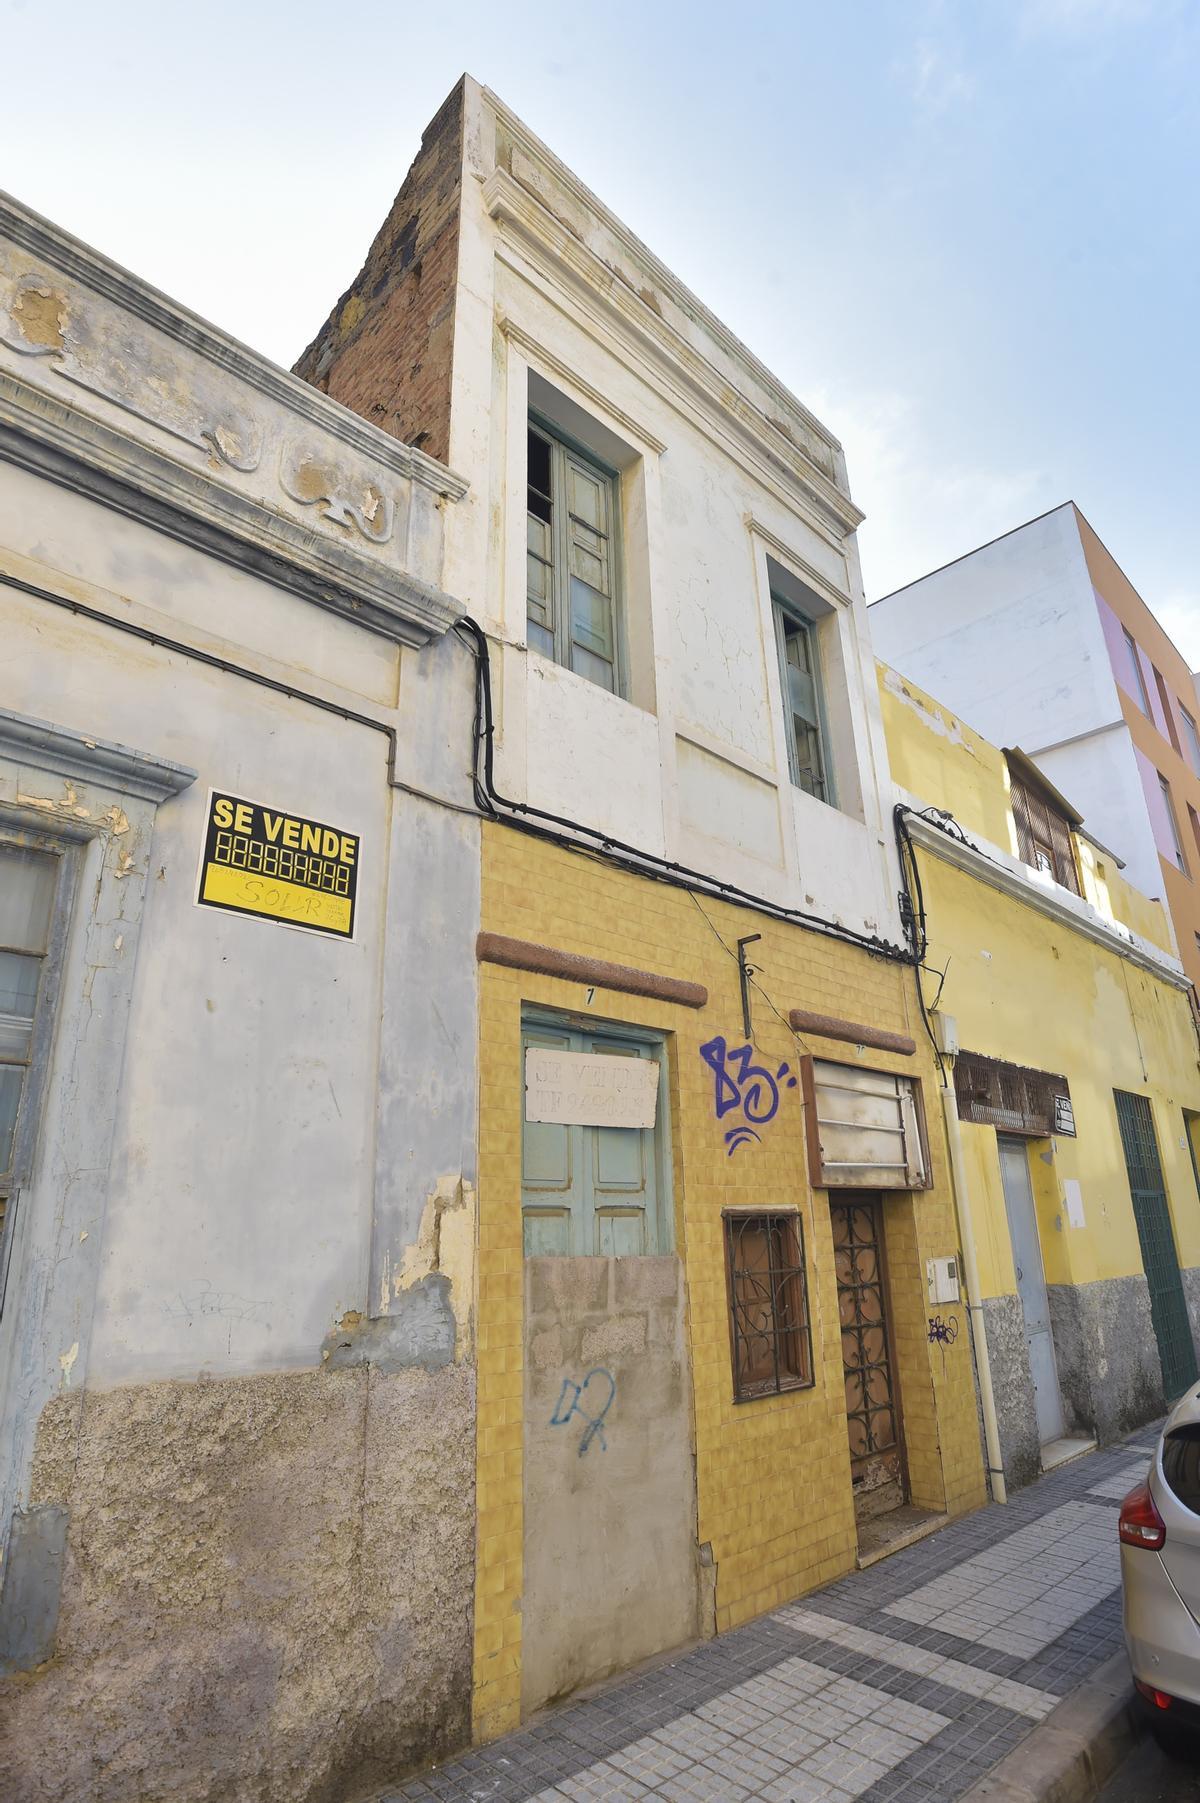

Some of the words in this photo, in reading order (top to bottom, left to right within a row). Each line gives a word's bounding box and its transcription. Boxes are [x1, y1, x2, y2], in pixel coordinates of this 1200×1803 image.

[213, 799, 254, 835] SE
[262, 812, 356, 865] VENDE
[587, 987, 595, 1005] 7
